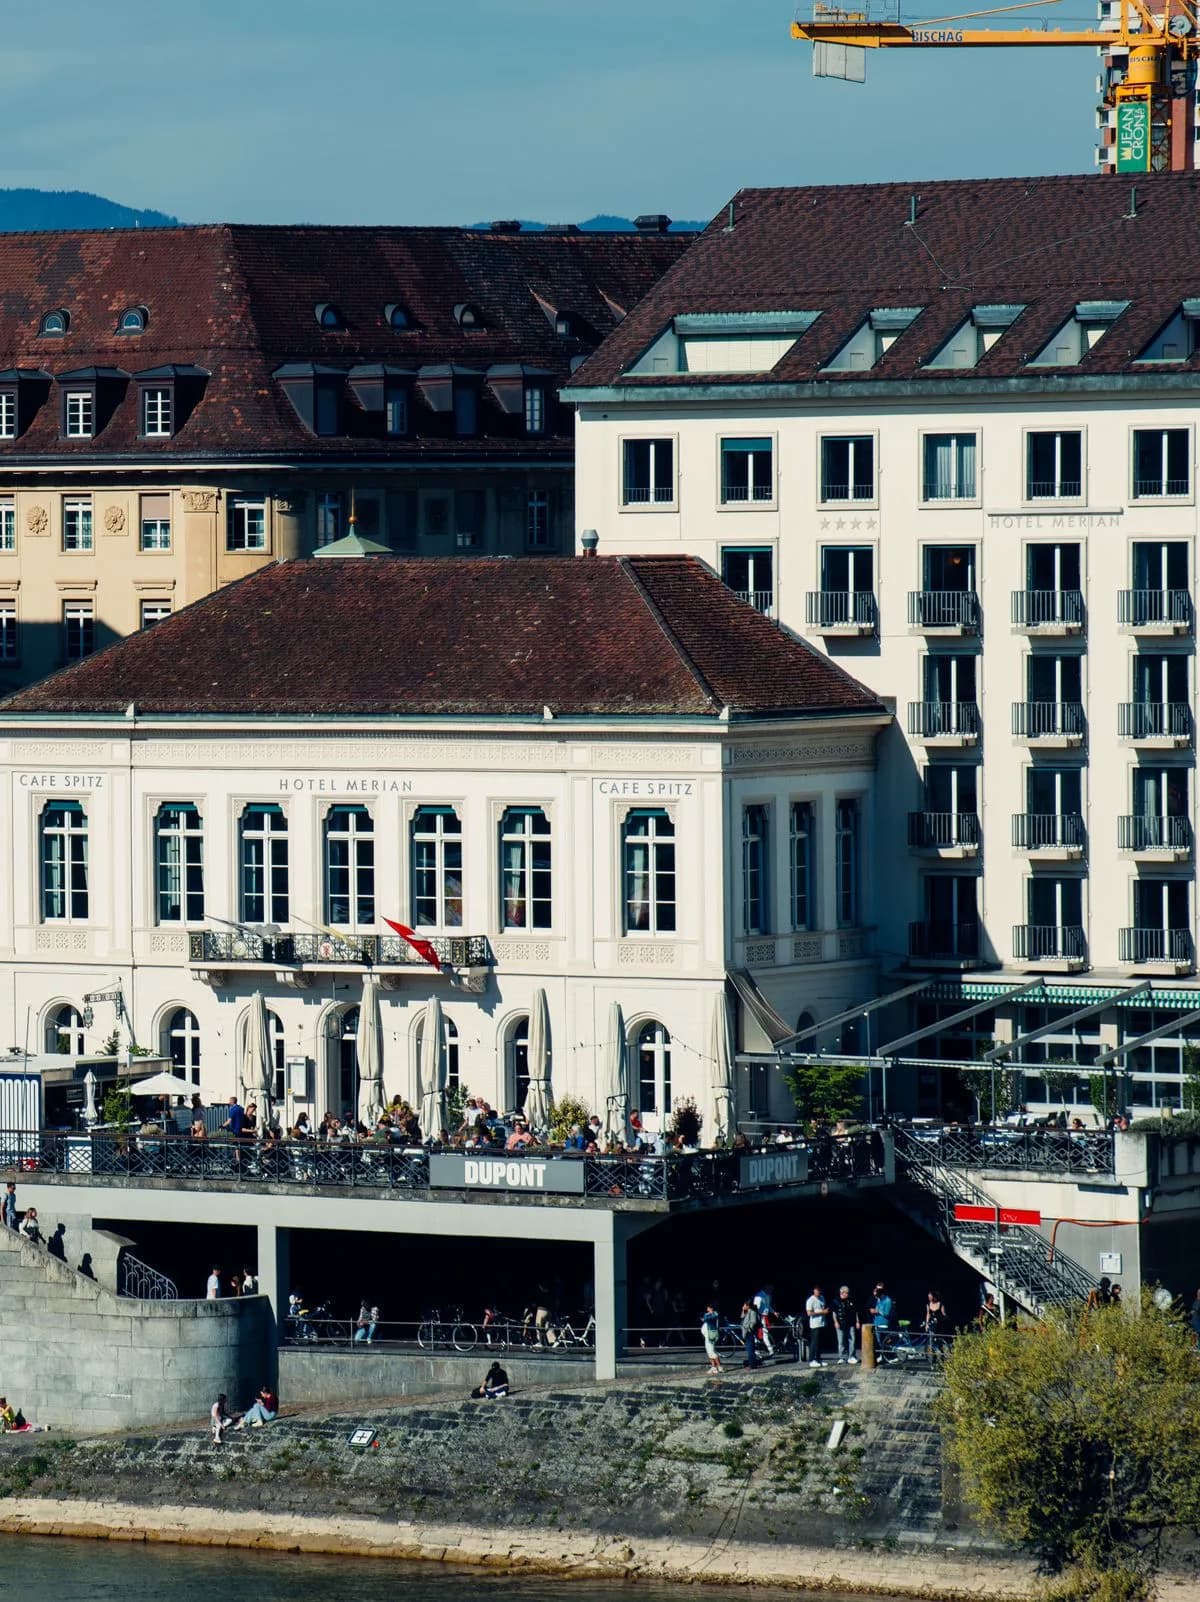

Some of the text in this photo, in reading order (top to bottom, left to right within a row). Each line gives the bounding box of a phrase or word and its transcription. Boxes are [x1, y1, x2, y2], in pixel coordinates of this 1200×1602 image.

[912, 31, 963, 42] BISCHAG
[1120, 108, 1133, 147] JEAN
[1132, 115, 1145, 160] CRON
[990, 516, 1120, 529] HOTEL MERIAN
[19, 774, 103, 788] CAFE SPITZ
[279, 778, 413, 792] HOTEL MERIAN
[599, 782, 693, 795] CAFE SPITZ
[464, 1160, 547, 1188] DUPONT
[749, 1155, 799, 1183] DUPONT
